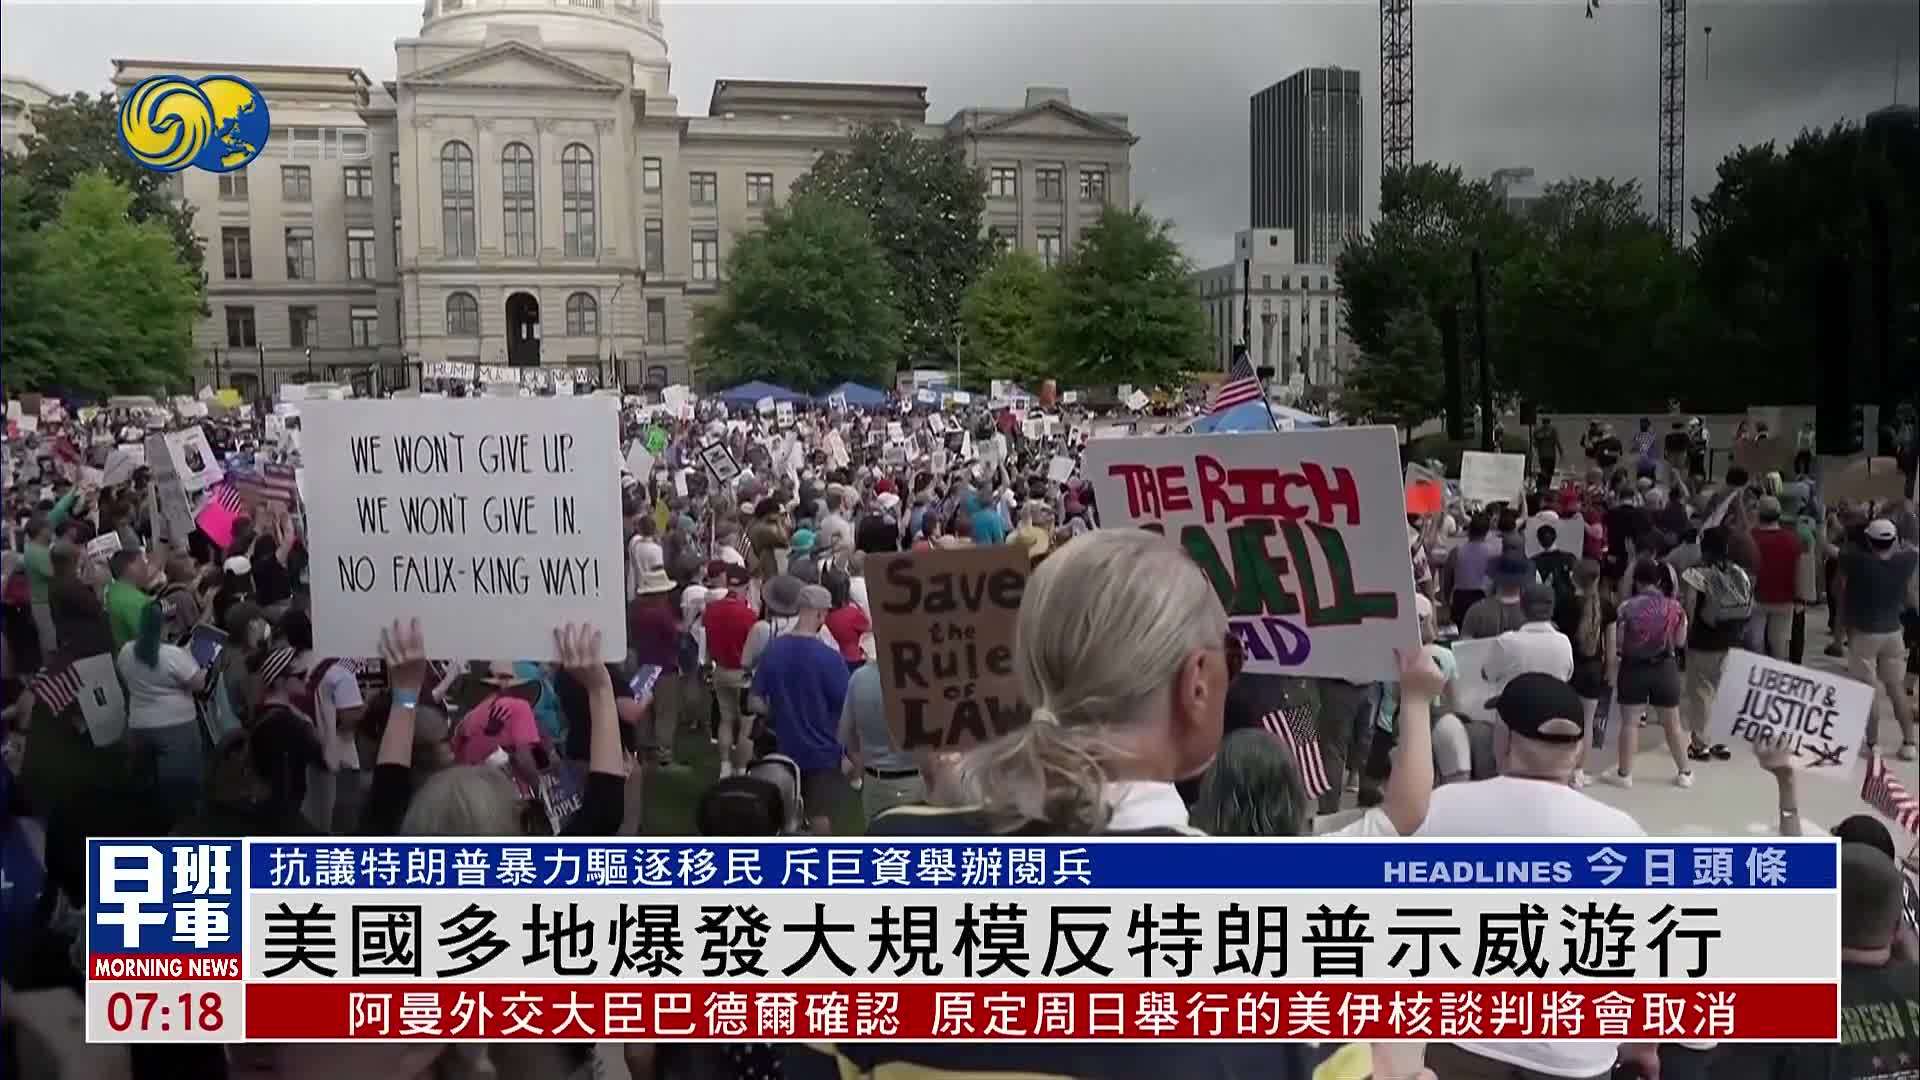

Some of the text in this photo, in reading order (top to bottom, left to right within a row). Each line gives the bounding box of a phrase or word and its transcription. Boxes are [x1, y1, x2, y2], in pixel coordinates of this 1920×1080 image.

[350, 431, 575, 474] WE WON'T GIVE UP.
[1107, 454, 1361, 526] THE RICH
[356, 492, 582, 535] WE WON'T GIVE IN.
[337, 555, 600, 597] NO FAUX-KING WAY!
[881, 558, 1025, 614] Save
[928, 622, 976, 644] the
[1228, 617, 1312, 667] AD
[890, 641, 1013, 689] Rule
[1748, 664, 1837, 708] LIBERTY &
[1731, 717, 1774, 747] FOR
[1738, 689, 1840, 741] JUSTICE
